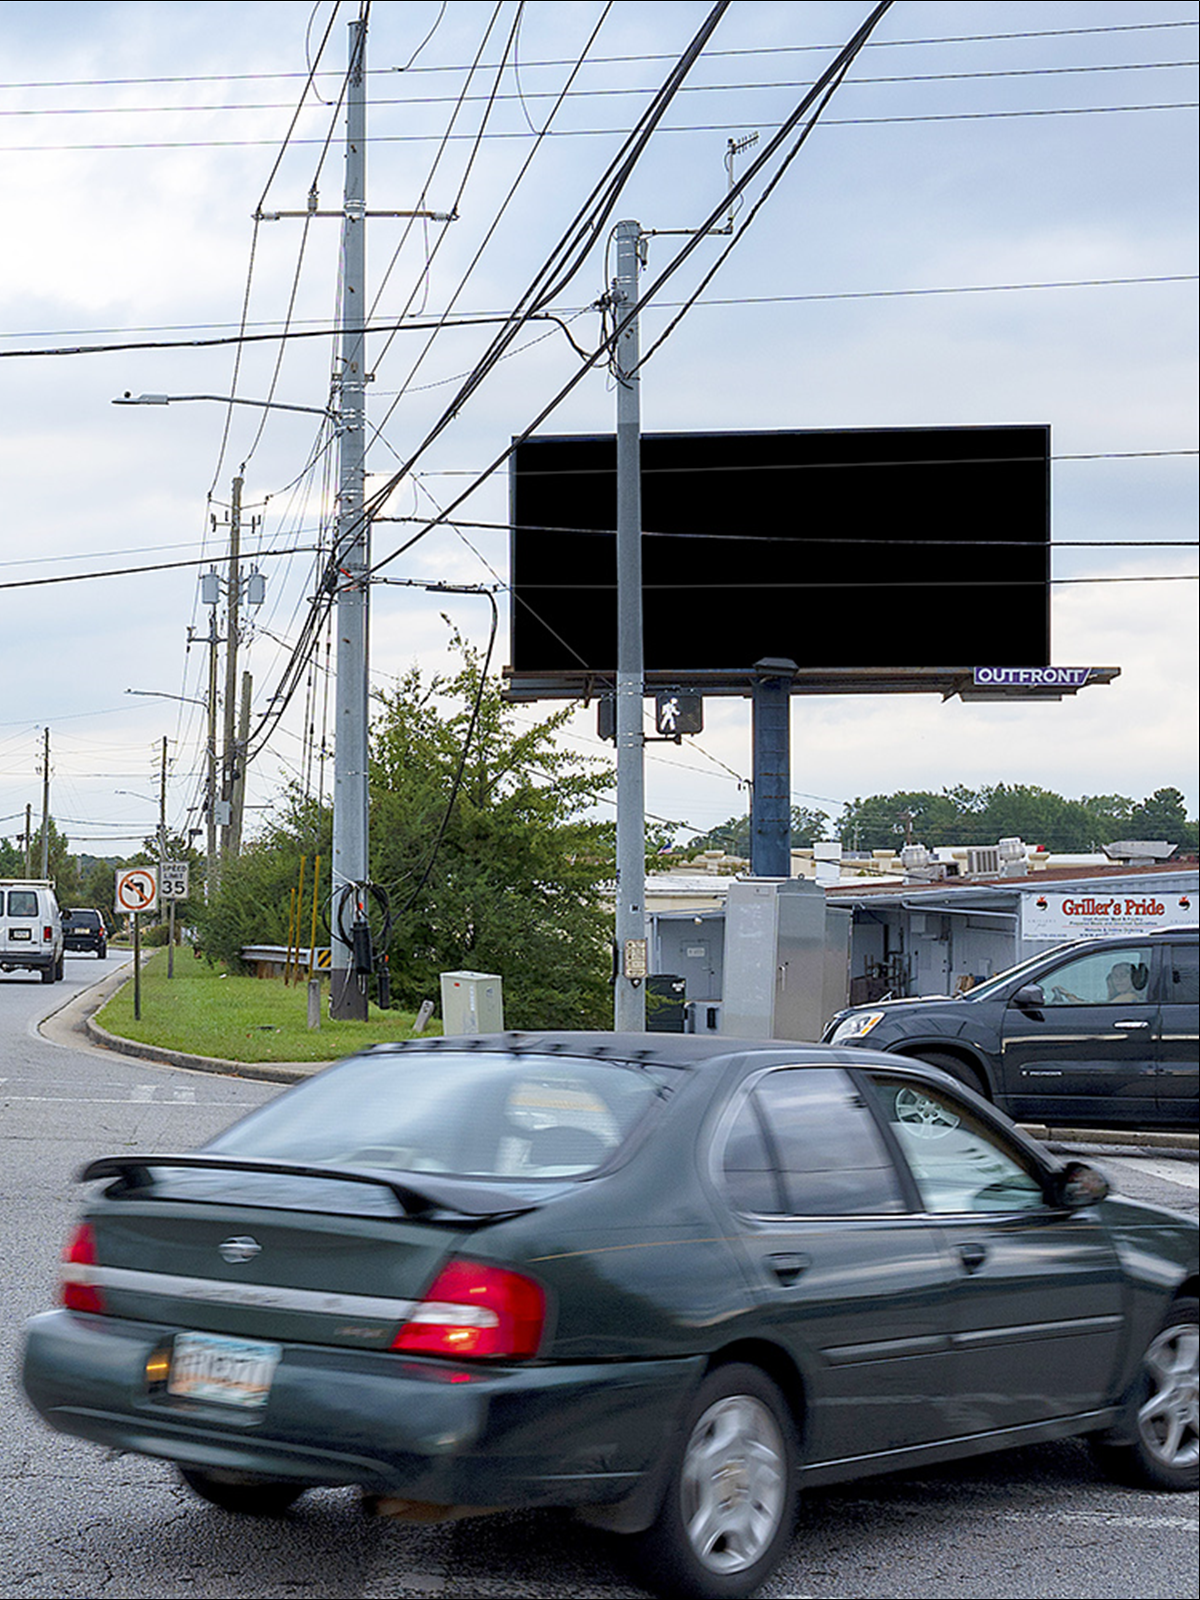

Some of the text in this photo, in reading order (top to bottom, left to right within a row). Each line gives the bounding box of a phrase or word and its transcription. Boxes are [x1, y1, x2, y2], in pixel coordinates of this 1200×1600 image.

[978, 668, 1084, 682] OUTFRONT
[162, 864, 187, 873] SPEED
[163, 872, 183, 880] LIMIT
[162, 880, 186, 895] 35
[1062, 898, 1165, 916] Griller's Pride
